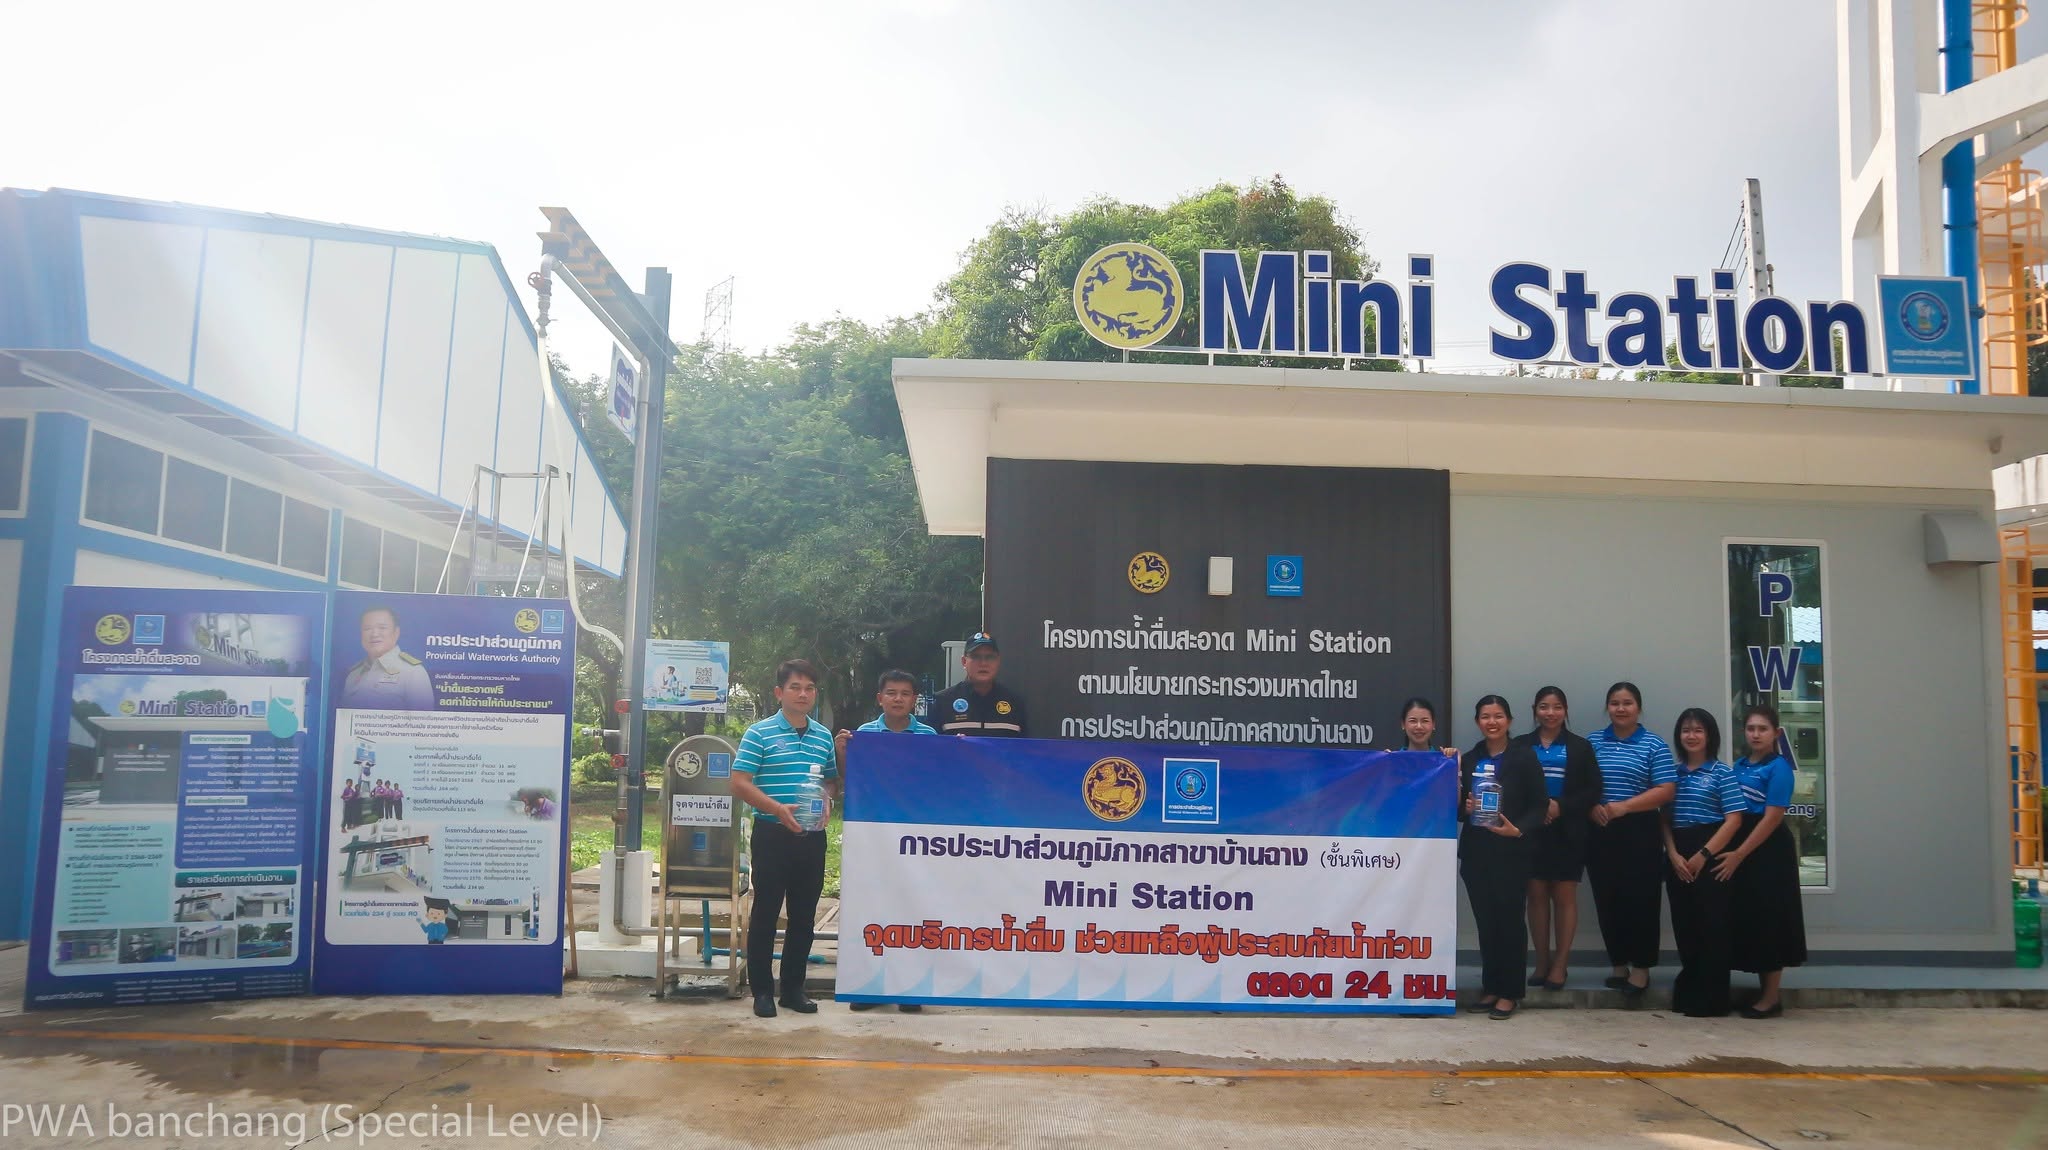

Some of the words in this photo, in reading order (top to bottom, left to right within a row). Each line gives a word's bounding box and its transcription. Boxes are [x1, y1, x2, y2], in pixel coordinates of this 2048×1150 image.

[1200, 249, 1435, 360] Mini
[1488, 261, 1871, 377] Station
[426, 634, 562, 652] การประปาส่วนภูมิภาค
[1043, 615, 1235, 653] โครงการน้ำดื่มสะอาด
[1247, 628, 1297, 652] Mini
[1309, 629, 1392, 654] Station
[82, 649, 201, 666] โครงการน้ำดื่มสะอาด
[425, 651, 465, 660] Provincial
[468, 653, 518, 662] Waterworks
[521, 655, 561, 665] Authority
[1078, 666, 1358, 699] ตามนโยบายกระทรวงมหาดไทย
[138, 700, 177, 716] Mini
[184, 700, 249, 716] Station
[1061, 712, 1373, 747] การประปาส่วนภูมิภาคสาขาบ้านฉาง
[676, 797, 730, 812] จุดจ่ายน้ำดื่ม
[899, 833, 1308, 868] การประปาส่วนภูมิภาคสาขาบ้านฉาง
[1320, 842, 1402, 870] (ชั้นพิเศษ)
[1044, 880, 1117, 908] Mini
[1131, 882, 1254, 911] Station
[863, 913, 1066, 956] จุดบริการน้ำดื่ม
[1075, 921, 1433, 964] ช่วยเหลือผู้ประสบภัยน้ำท่วม
[1247, 970, 1333, 999] ตลอด
[1345, 970, 1391, 999] 24
[1404, 973, 1457, 1001] ชม.
